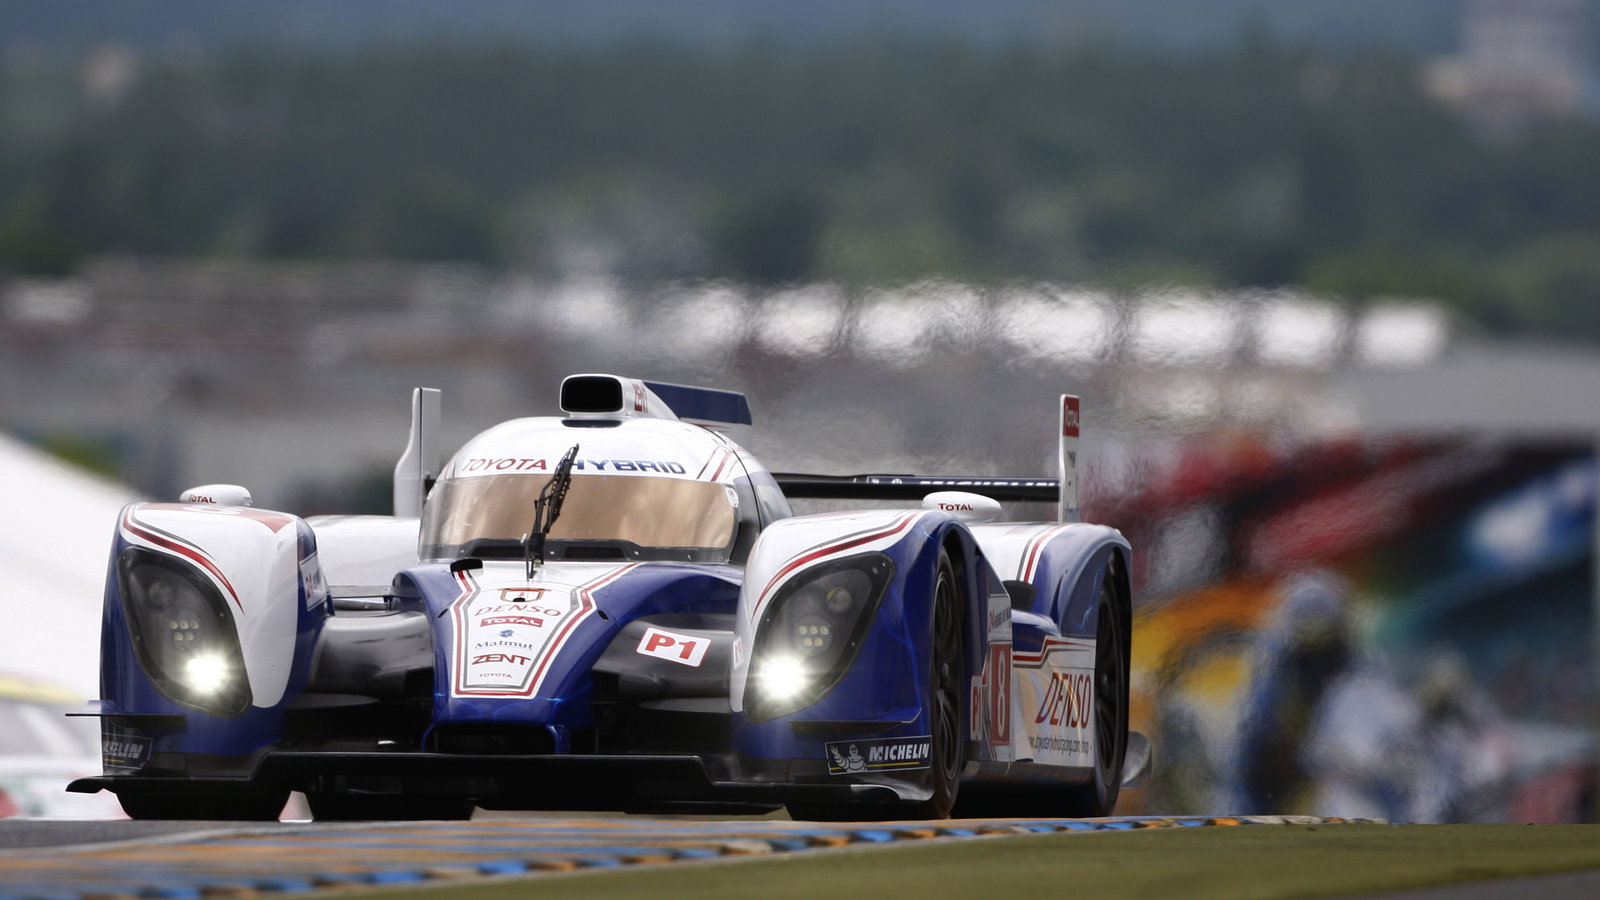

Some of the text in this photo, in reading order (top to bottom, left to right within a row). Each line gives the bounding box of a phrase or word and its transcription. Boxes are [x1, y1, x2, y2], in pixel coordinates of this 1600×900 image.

[462, 458, 687, 475] TOYOTA HYBRID
[189, 495, 217, 504] TOTAL
[938, 503, 974, 512] TOTAL
[474, 604, 562, 617] DENSO
[484, 617, 541, 627] TOTAL
[475, 640, 534, 650] Matmut
[645, 633, 697, 660] P1
[471, 653, 532, 666] ZENT
[1035, 672, 1092, 729] DENSO
[868, 743, 930, 762] MICHELIN
